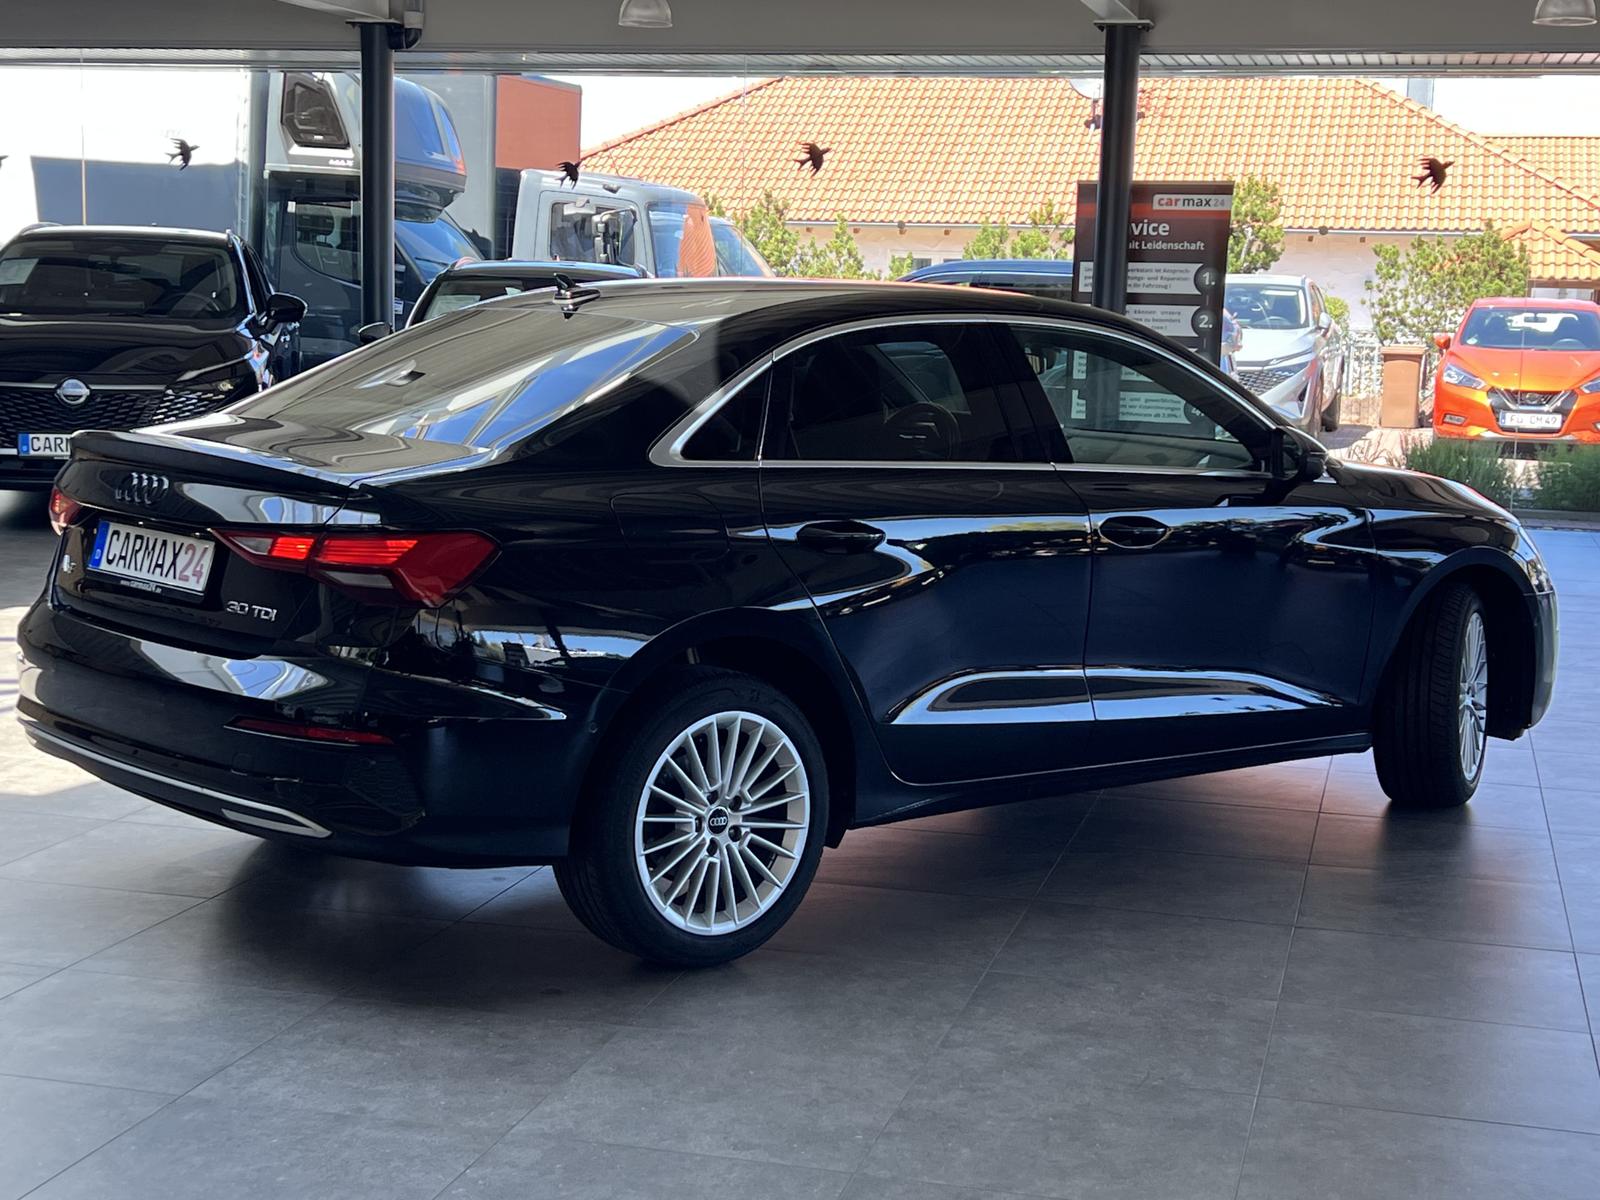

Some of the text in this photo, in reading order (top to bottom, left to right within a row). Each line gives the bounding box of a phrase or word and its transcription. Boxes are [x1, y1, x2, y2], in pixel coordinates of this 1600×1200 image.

[1130, 219, 1170, 236] vice
[1141, 240, 1205, 251] Leidenschaft
[1202, 272, 1215, 285] 1.
[1198, 315, 1213, 328] 2.
[106, 529, 209, 584] CARMAX24
[226, 600, 278, 622] 30 TDI
